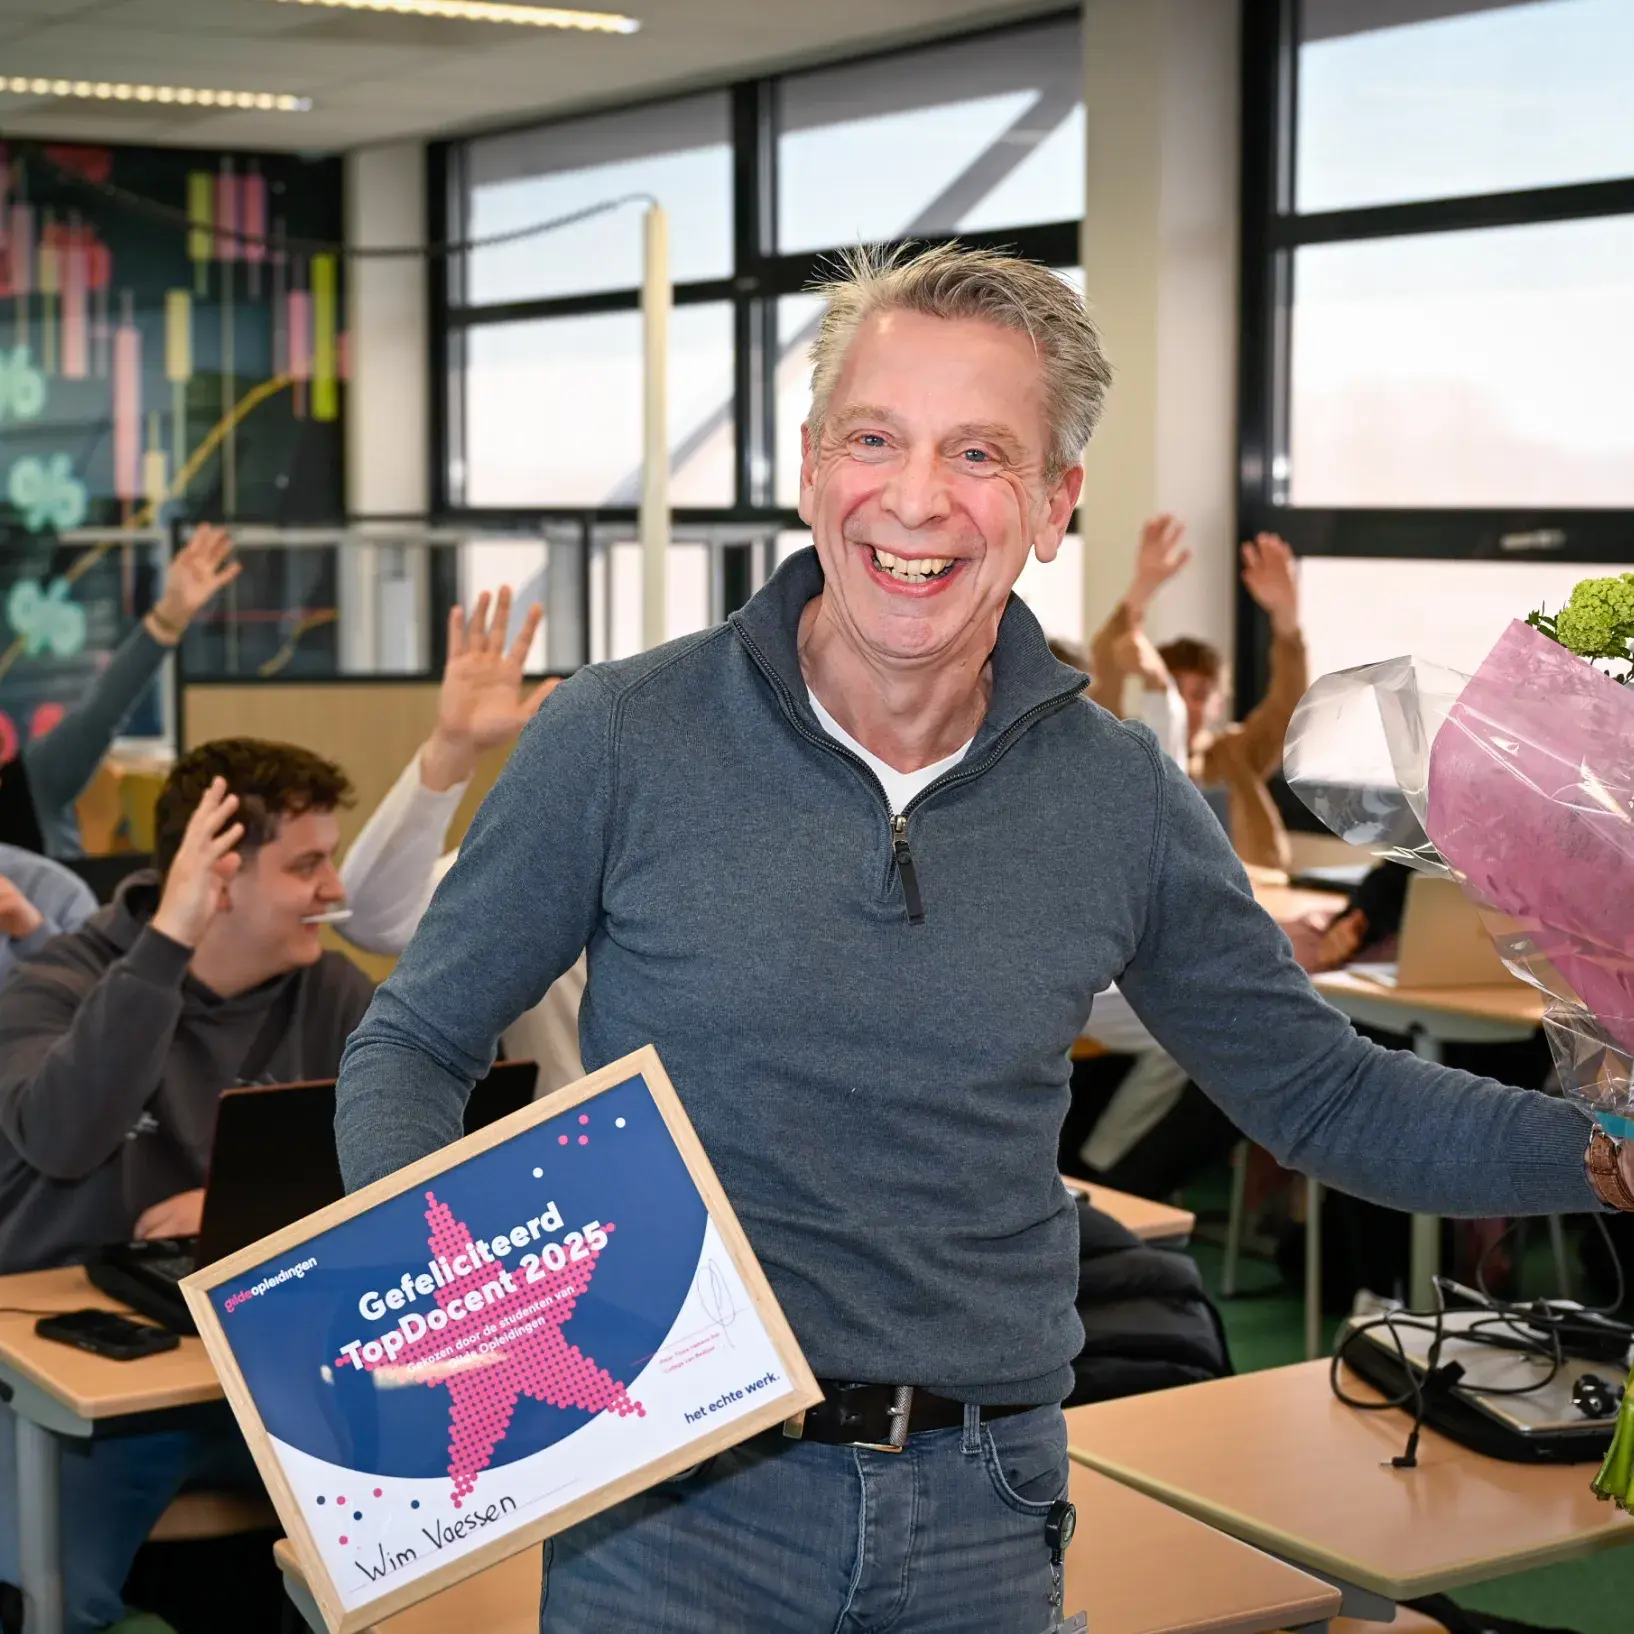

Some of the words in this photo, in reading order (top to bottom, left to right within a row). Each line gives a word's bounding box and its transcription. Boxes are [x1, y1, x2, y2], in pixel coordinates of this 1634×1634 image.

[340, 1269, 518, 1371] TopDocent
[519, 1220, 609, 1284] 2025
[358, 1200, 565, 1321] Gefeliciteerd
[406, 1345, 454, 1373] Gekozen
[454, 1331, 482, 1350] door
[483, 1322, 499, 1337] de
[499, 1296, 554, 1329] studenten
[554, 1285, 576, 1300] van
[478, 1316, 546, 1354] Opleidingen
[684, 1406, 708, 1424] het
[708, 1390, 744, 1412] echte
[744, 1372, 781, 1394] werk.
[355, 1542, 417, 1582] Wim
[422, 1496, 517, 1550] Vaessen
